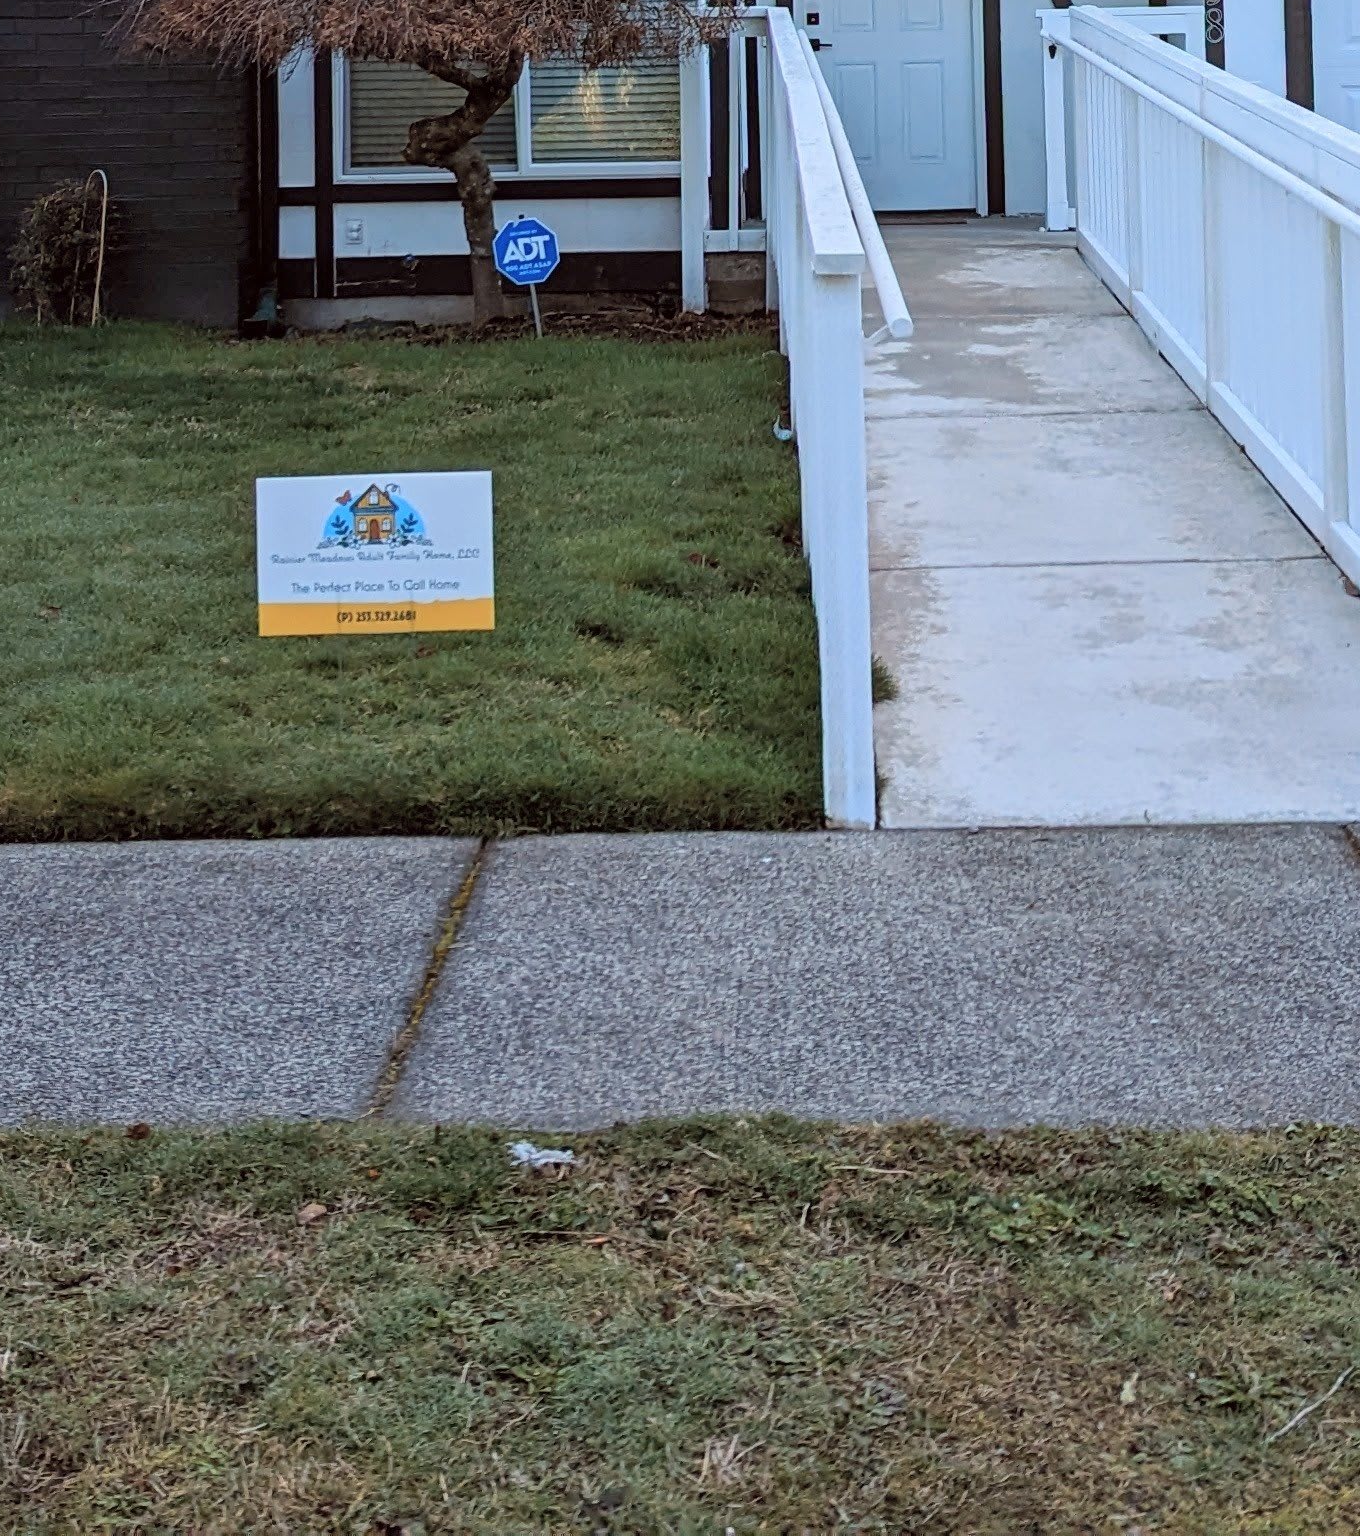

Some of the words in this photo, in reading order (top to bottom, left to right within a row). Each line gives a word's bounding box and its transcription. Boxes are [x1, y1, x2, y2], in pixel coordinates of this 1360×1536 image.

[502, 234, 551, 264] ADT
[457, 548, 480, 559] LLC
[291, 582, 311, 594] The
[314, 581, 351, 593] Perfect
[354, 580, 384, 592] Place
[387, 580, 400, 591] To
[403, 579, 426, 590] Call
[429, 579, 460, 590] Home
